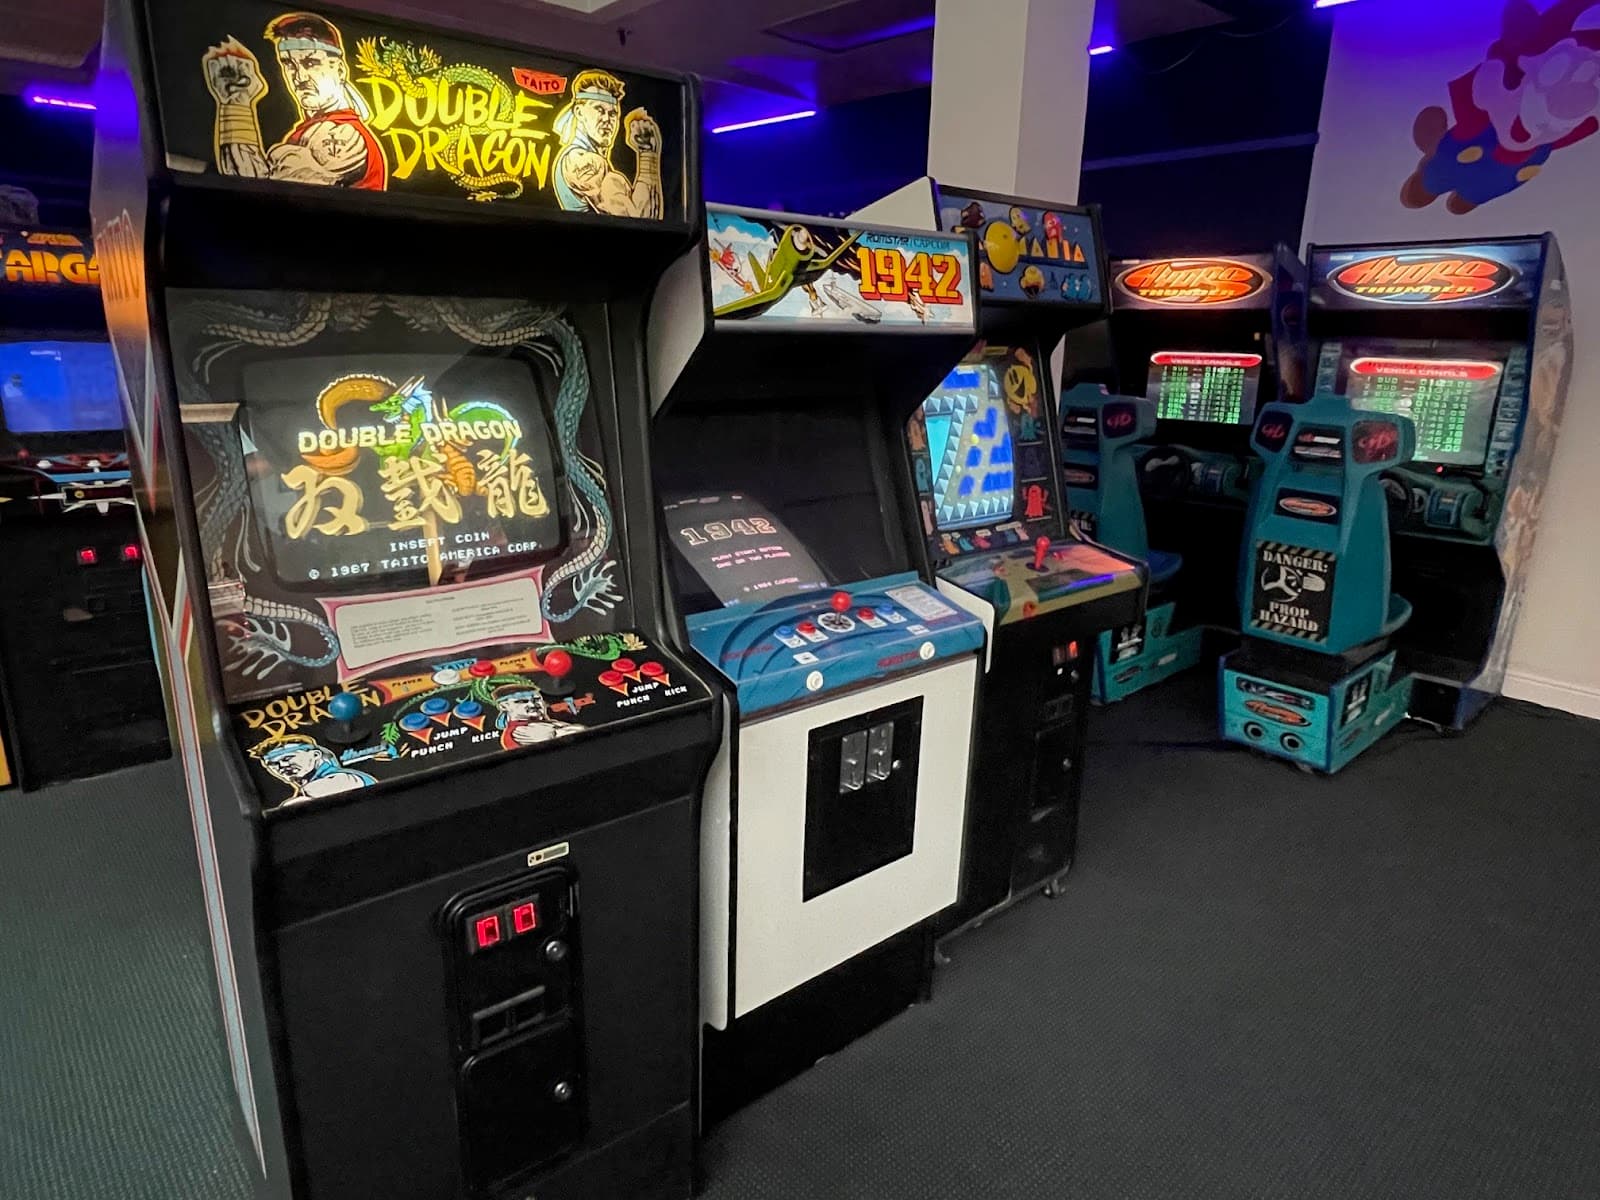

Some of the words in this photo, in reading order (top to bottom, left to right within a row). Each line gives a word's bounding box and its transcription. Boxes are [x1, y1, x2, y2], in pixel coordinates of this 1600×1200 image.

[521, 75, 560, 91] TAITO
[356, 76, 553, 140] DOUBLE
[381, 123, 551, 191] DRAGON
[857, 246, 964, 306] 1942
[1338, 256, 1499, 299] HYDRO
[1138, 288, 1235, 297] THUNDER
[1354, 285, 1478, 295] THUNDER
[1376, 366, 1416, 375] VENICE
[299, 424, 413, 453] DOUBLE
[421, 419, 523, 445] DRAGON
[390, 536, 446, 552] INSERT
[455, 531, 490, 543] COIN
[680, 517, 777, 546] 1942
[331, 562, 371, 578] 1987
[381, 555, 431, 570] TAITO
[439, 545, 501, 562] AMERICA
[1262, 550, 1329, 573] DANGER:
[1269, 601, 1310, 618] PROP
[1259, 609, 1319, 633] HAZARD
[631, 682, 660, 694] JUMP
[664, 685, 688, 697] KICK
[240, 678, 370, 729] DOUBLE
[616, 694, 650, 708] PUNCH
[259, 691, 381, 741] DRAN
[433, 726, 469, 741] JUMP
[472, 730, 500, 743] KICK
[411, 741, 453, 758] PUNCH
